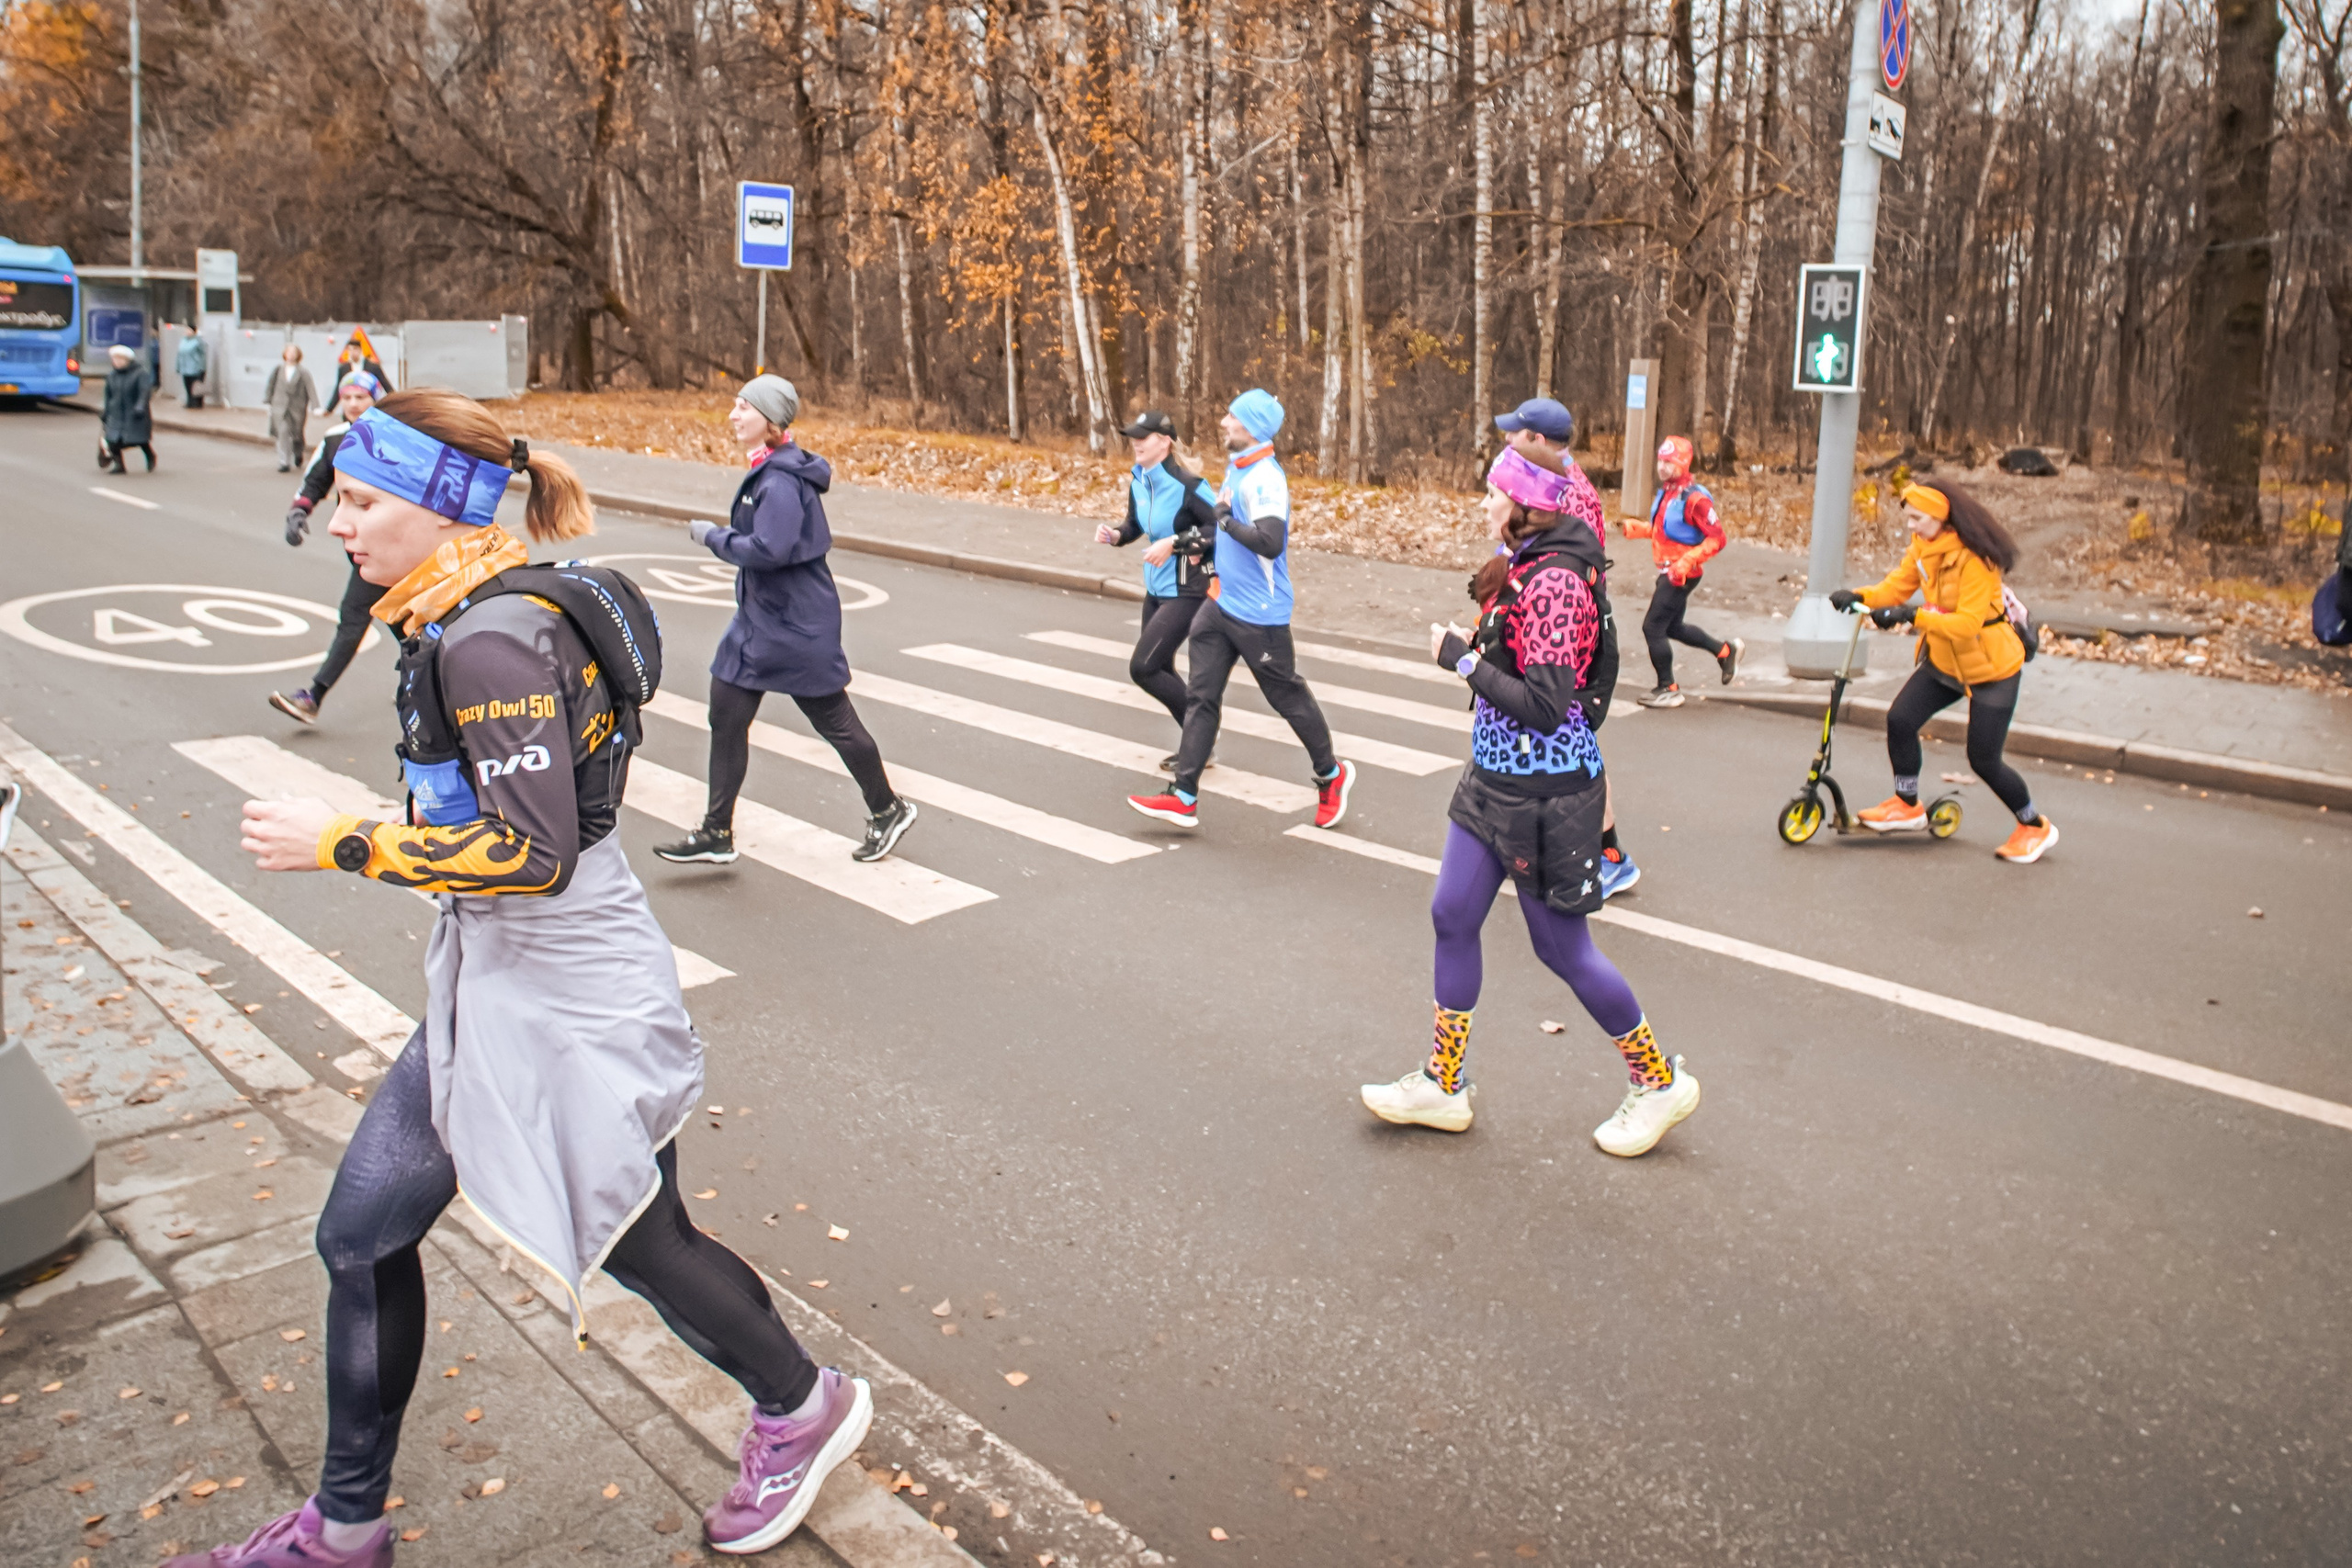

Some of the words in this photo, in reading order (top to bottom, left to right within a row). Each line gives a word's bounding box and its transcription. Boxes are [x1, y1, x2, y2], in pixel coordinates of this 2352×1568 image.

[94, 599, 311, 647] 40
[488, 697, 526, 719] Owl
[528, 694, 556, 719] 50
